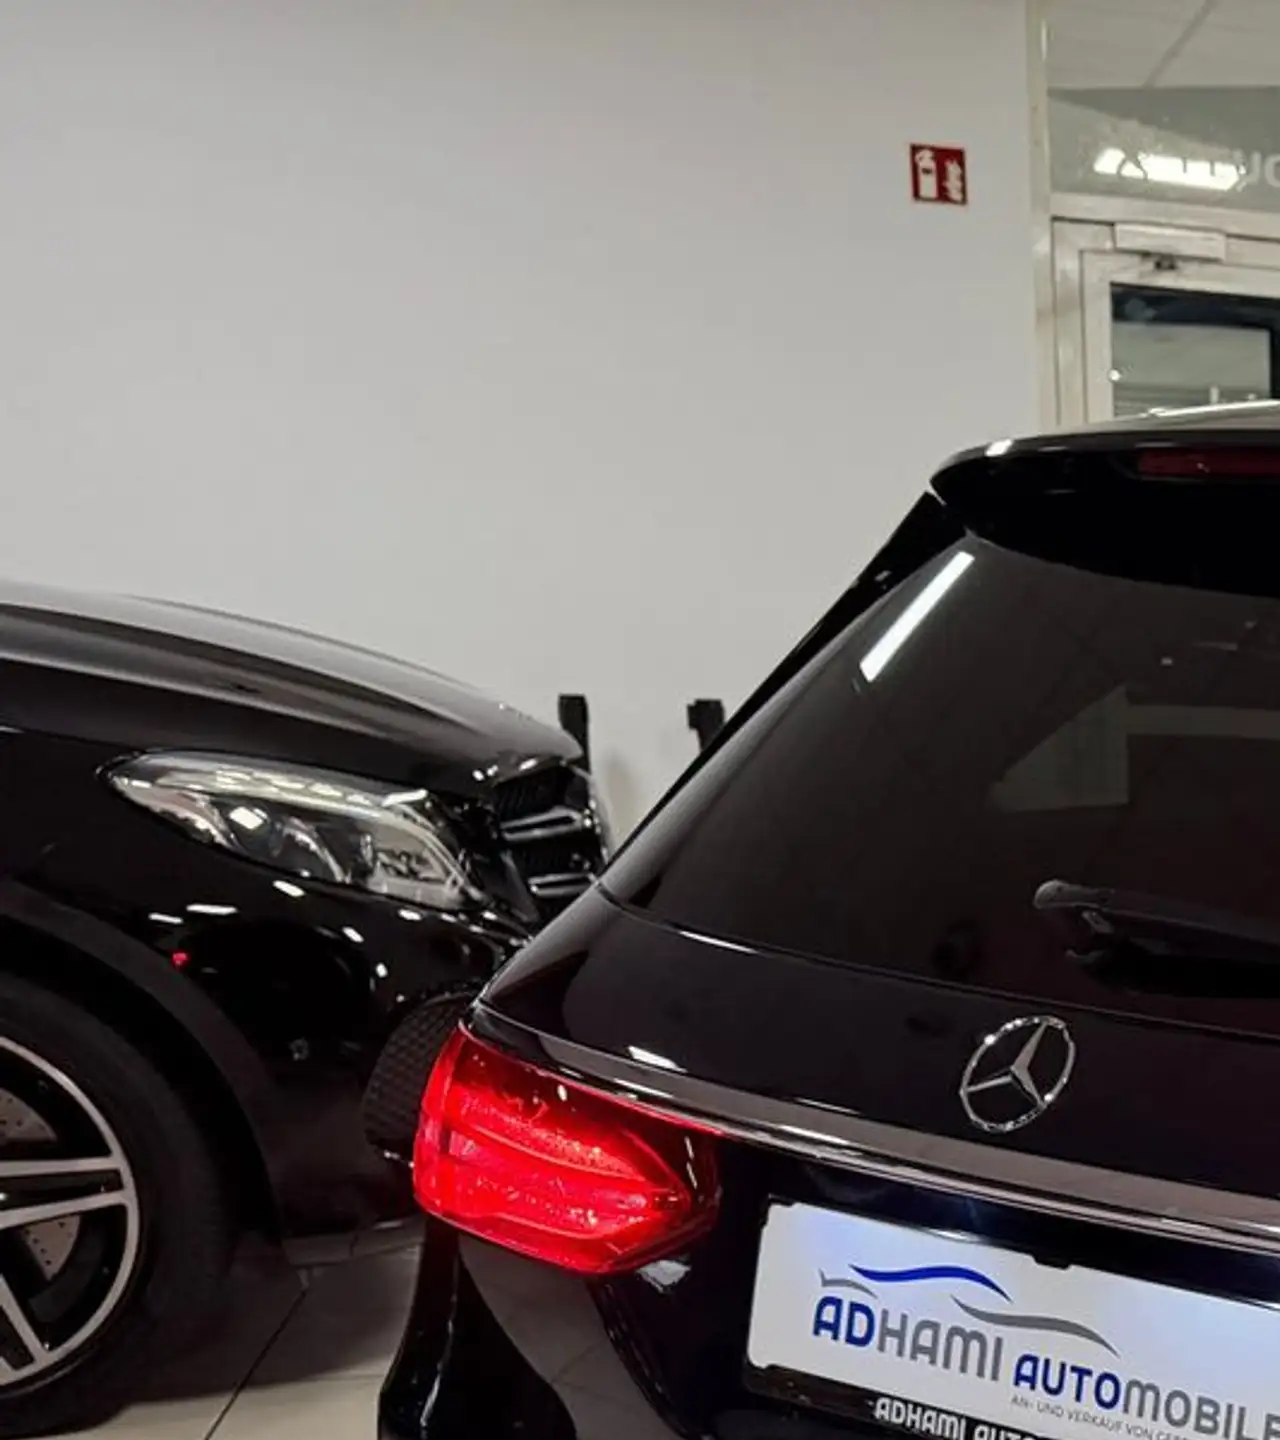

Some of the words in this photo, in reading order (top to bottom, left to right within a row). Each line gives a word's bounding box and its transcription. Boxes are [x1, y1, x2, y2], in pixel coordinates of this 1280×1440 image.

[813, 1295, 1004, 1382] ADHAMI
[1037, 1401, 1064, 1418] UND
[1068, 1410, 1124, 1431] VERKAUF
[1126, 1423, 1153, 1440] VON
